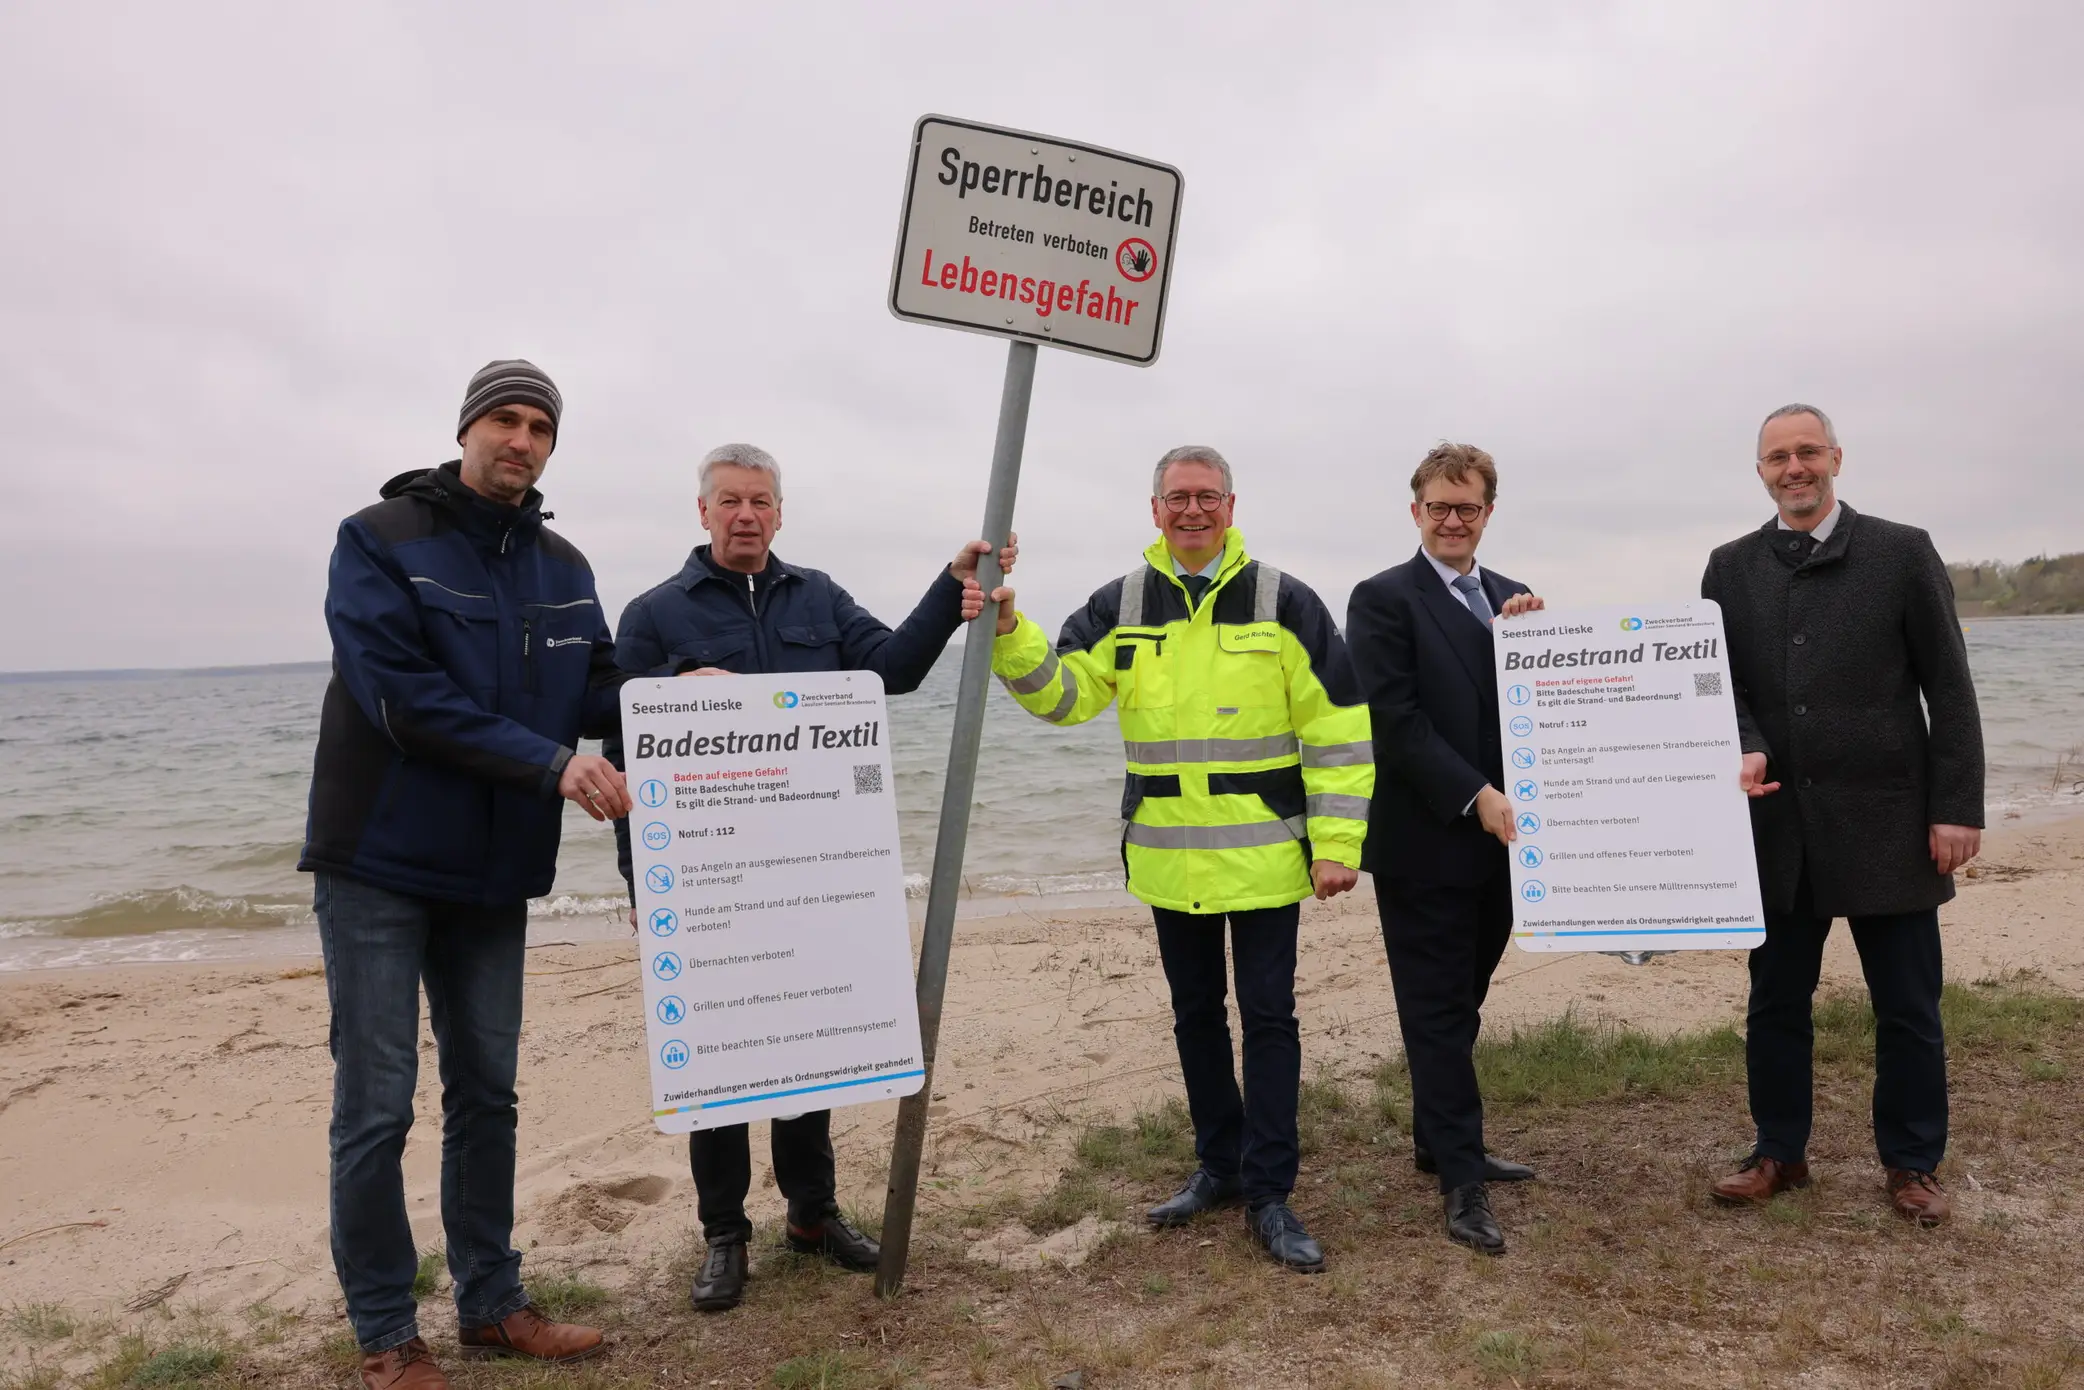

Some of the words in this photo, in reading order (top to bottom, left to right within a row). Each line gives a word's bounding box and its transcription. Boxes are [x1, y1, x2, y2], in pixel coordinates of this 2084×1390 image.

[938, 148, 1153, 227] Sperrbereich
[969, 216, 1034, 244] Betreten
[1044, 233, 1108, 259] verboten
[921, 249, 1138, 326] Lebensgefahr
[1645, 617, 1693, 625] Zweckverband
[1502, 628, 1555, 638] Seestrand
[1559, 625, 1593, 635] Lieske
[1505, 644, 1644, 671] Badestrand
[1652, 639, 1717, 661] Textil
[1577, 677, 1603, 686] eigene
[1605, 675, 1633, 683] Gefahr!
[1557, 687, 1605, 695] Badeschuhe
[1606, 685, 1635, 693] tragen!
[632, 701, 698, 714] Seestrand
[702, 699, 742, 711] Lieske
[1548, 699, 1562, 708] gilt
[1577, 696, 1606, 704] Strand-
[1625, 692, 1681, 702] Badeordnung!
[1539, 721, 1565, 729] Notruf
[636, 726, 799, 758] Badestrand
[809, 721, 879, 749] Textil
[1558, 746, 1585, 754] Angeln
[1599, 742, 1661, 752] ausgewiesenen
[1663, 739, 1731, 749] Strandbereichen
[1555, 756, 1594, 765] untersagt!
[674, 772, 703, 781] Baden
[705, 771, 720, 780] auf
[722, 770, 752, 780] eigene
[755, 767, 788, 777] Gefahr!
[1544, 779, 1570, 787] Hunde
[1586, 777, 1613, 785] Strand
[1632, 775, 1646, 783] auf
[1665, 772, 1716, 783] Liegewiesen
[675, 786, 698, 795] Bitte
[700, 782, 755, 793] Badeschuhe
[757, 781, 790, 791] tragen!
[1545, 791, 1583, 799] verboten!
[676, 800, 687, 808] Es
[689, 798, 705, 809] gilt
[707, 797, 721, 806] die
[724, 794, 757, 805] Strand-
[760, 793, 777, 803] und
[779, 790, 840, 802] Badeordnung!
[1547, 817, 1599, 827] Übernachten
[1601, 816, 1640, 824] verboten!
[647, 832, 667, 840] SOS
[678, 828, 708, 839] Notruf
[716, 827, 735, 836] 112
[681, 865, 699, 874] Das
[701, 862, 733, 872] Angeln
[749, 855, 817, 869] ausgewiesenen
[820, 848, 891, 861] Strandbereichen
[1550, 852, 1577, 860] Grillen
[1579, 851, 1594, 859] und
[1596, 850, 1627, 858] offenes
[1654, 848, 1694, 857] verboten!
[682, 879, 694, 887] ist
[697, 874, 743, 887] untersagt!
[1552, 885, 1572, 893] Bitte
[1573, 884, 1612, 893] beachten
[1614, 883, 1627, 892] Sie
[1659, 881, 1737, 891] Mülltrennsysteme!
[685, 906, 715, 916] Hunde
[717, 905, 732, 913] am
[734, 901, 765, 912] Strand
[767, 899, 784, 909] und
[786, 897, 801, 906] auf
[803, 895, 820, 905] den
[822, 890, 875, 903] Liegewiesen
[686, 920, 731, 933] verboten!
[1523, 919, 1596, 927] Zuwiderhandlungen
[1626, 917, 1637, 925] als
[1639, 916, 1714, 925] Ordnungswidrigkeit
[1715, 915, 1755, 924] geahndet!
[689, 954, 749, 969] Übernachten
[751, 949, 795, 962] verboten!
[693, 1001, 725, 1012] Grillen
[727, 998, 745, 1008] und
[747, 994, 782, 1005] offenes
[783, 990, 808, 1001] Feuer
[810, 984, 852, 997] verboten!
[697, 1044, 719, 1055] Bitte
[722, 1038, 764, 1051] beachten
[767, 1036, 781, 1045] Sie
[783, 1031, 814, 1042] unsere
[816, 1019, 896, 1038] Mülltrennsysteme!
[664, 1083, 747, 1102] Zuwiderhandlungen
[749, 1077, 779, 1089] werden
[781, 1075, 793, 1085] als
[795, 1063, 873, 1083] Ordnungswidrigkeit
[875, 1057, 914, 1071] geahndet!
